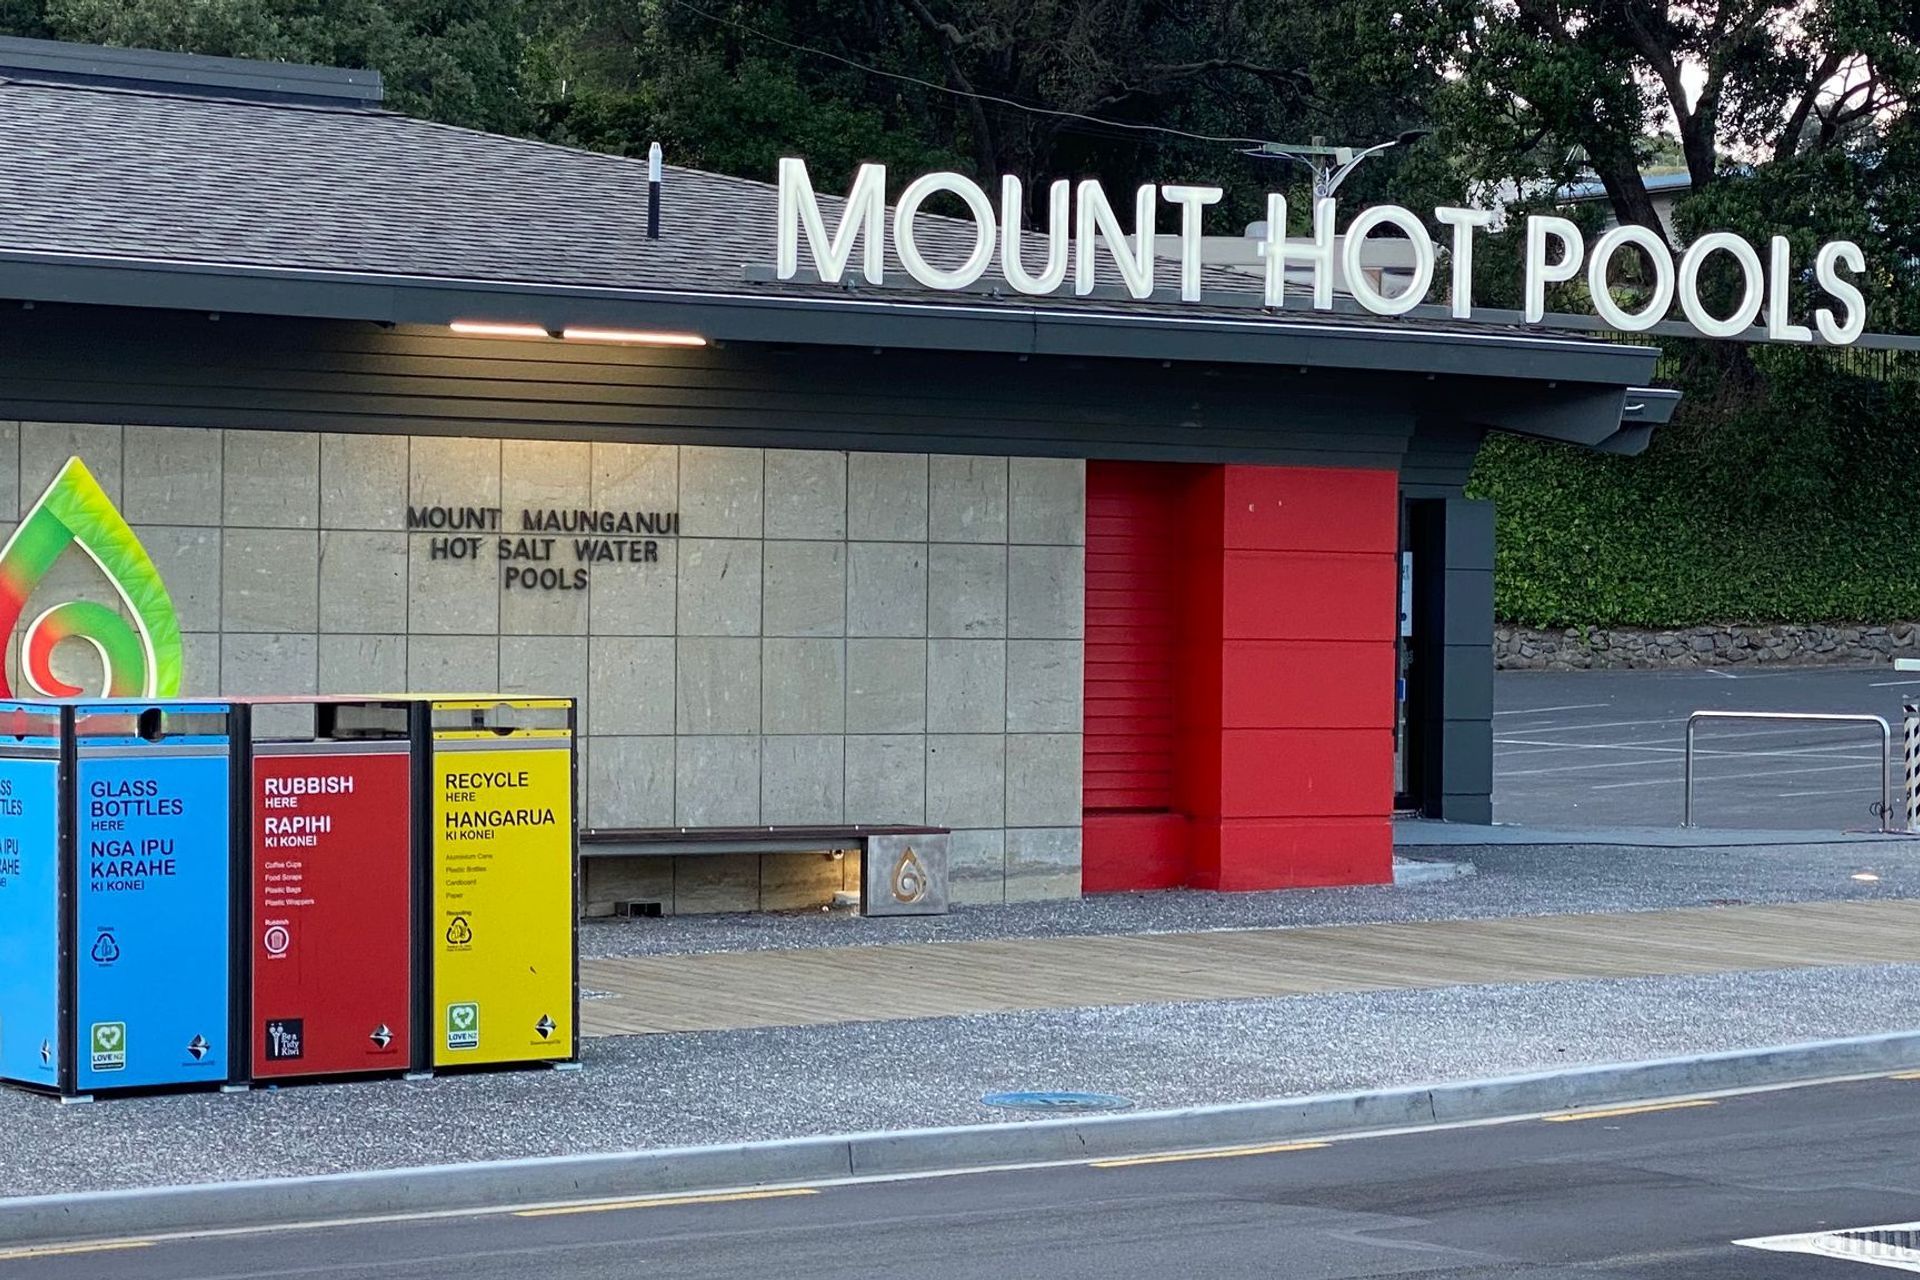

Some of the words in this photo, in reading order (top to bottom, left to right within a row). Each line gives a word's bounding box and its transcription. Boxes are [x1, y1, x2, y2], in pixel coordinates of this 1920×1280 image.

[777, 156, 1223, 304] MOUNT
[1257, 193, 1492, 317] HOT
[1525, 214, 1866, 345] POOLS
[408, 507, 501, 530] MOUNT
[523, 509, 679, 534] MAUNGANUI
[431, 537, 482, 560] HOT
[499, 538, 555, 561] SALT
[575, 540, 658, 562] WATER
[505, 567, 587, 590] POOLS
[91, 780, 158, 798] GLASS
[265, 776, 353, 795] RUBBISH
[446, 771, 528, 789] RECYCLE
[265, 797, 297, 808] HERE
[446, 791, 476, 802] HERE
[91, 799, 183, 817] BOTTLES
[91, 820, 125, 831] HERE
[265, 816, 331, 834] RAPIHI
[446, 809, 555, 828] HANGARUA
[265, 837, 277, 847] KI
[280, 835, 317, 847] KONEI
[446, 831, 457, 840] KI
[460, 829, 495, 840] KONEI
[91, 840, 135, 858] NGA
[141, 839, 174, 856] IPU
[91, 859, 176, 878] KARAHE
[91, 881, 103, 892] KI
[107, 880, 144, 892] KONEI
[281, 1040, 300, 1048] Tidy
[449, 1033, 467, 1041] LOVE
[93, 1054, 112, 1062] LOVE
[281, 1047, 299, 1056] Kiwi
